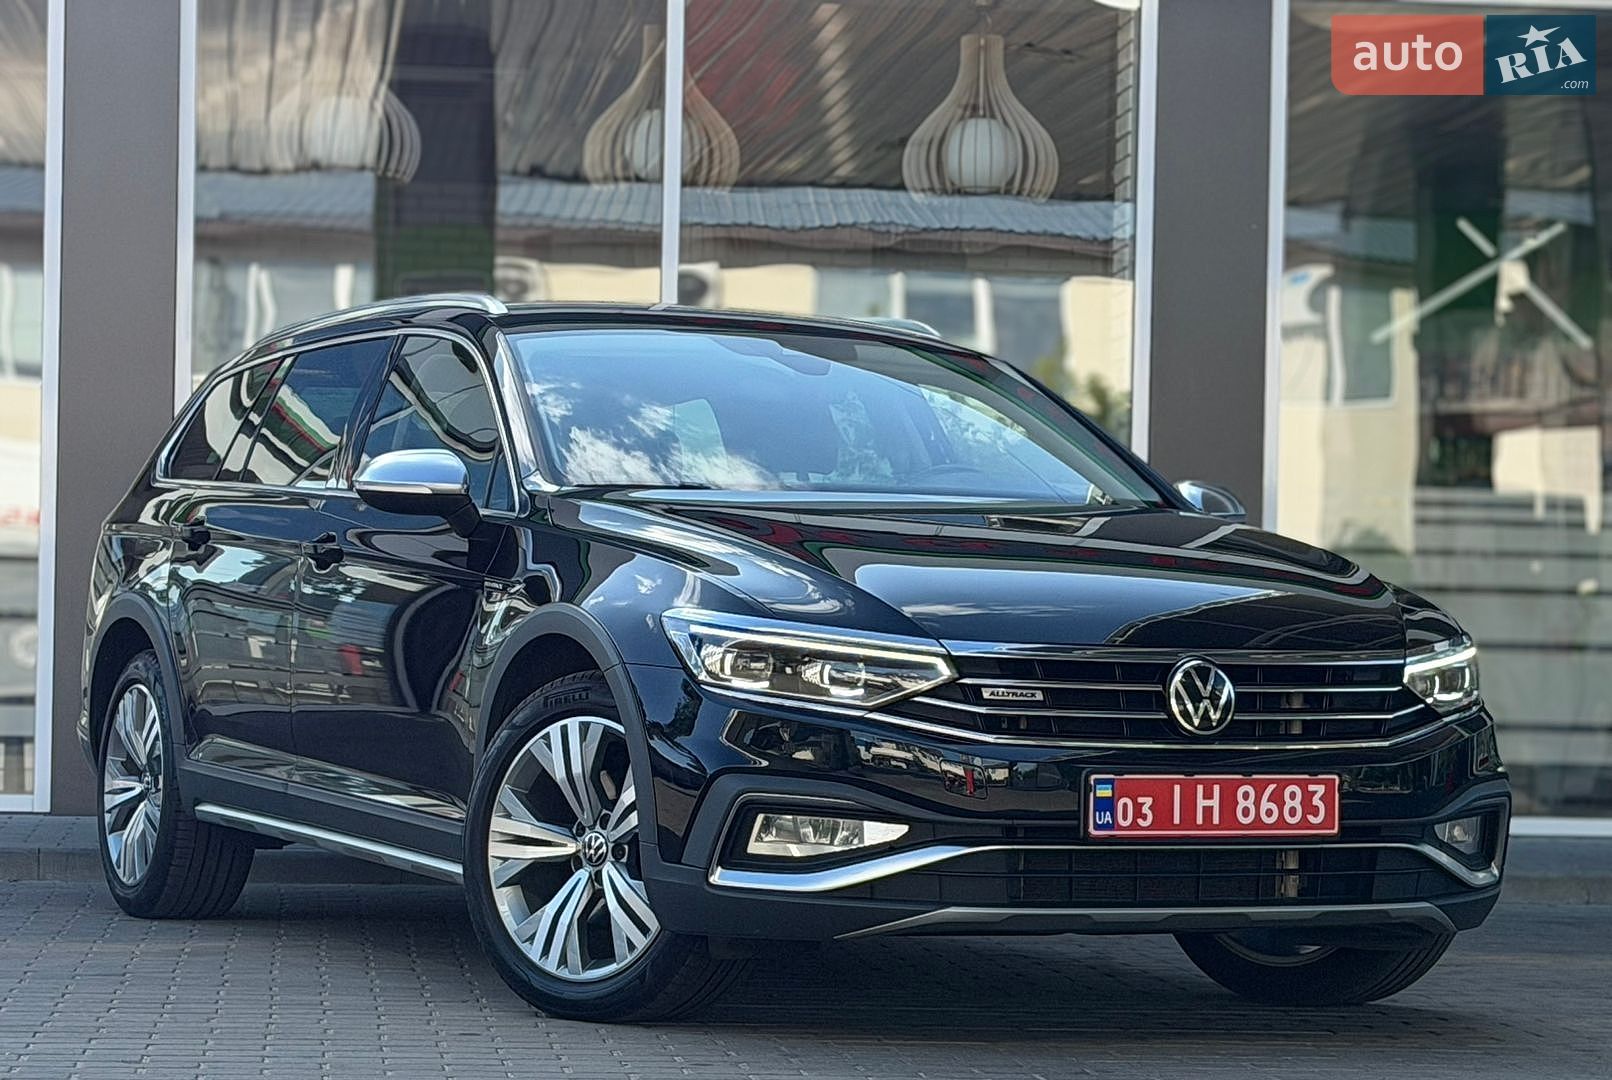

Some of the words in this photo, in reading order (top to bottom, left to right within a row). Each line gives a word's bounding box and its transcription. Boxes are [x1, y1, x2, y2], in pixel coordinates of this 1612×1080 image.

[989, 689, 1038, 699] ALLTRACK
[1117, 797, 1154, 828] 03
[1173, 784, 1221, 825] IH
[1235, 783, 1327, 825] 8683
[1096, 811, 1113, 825] UA
